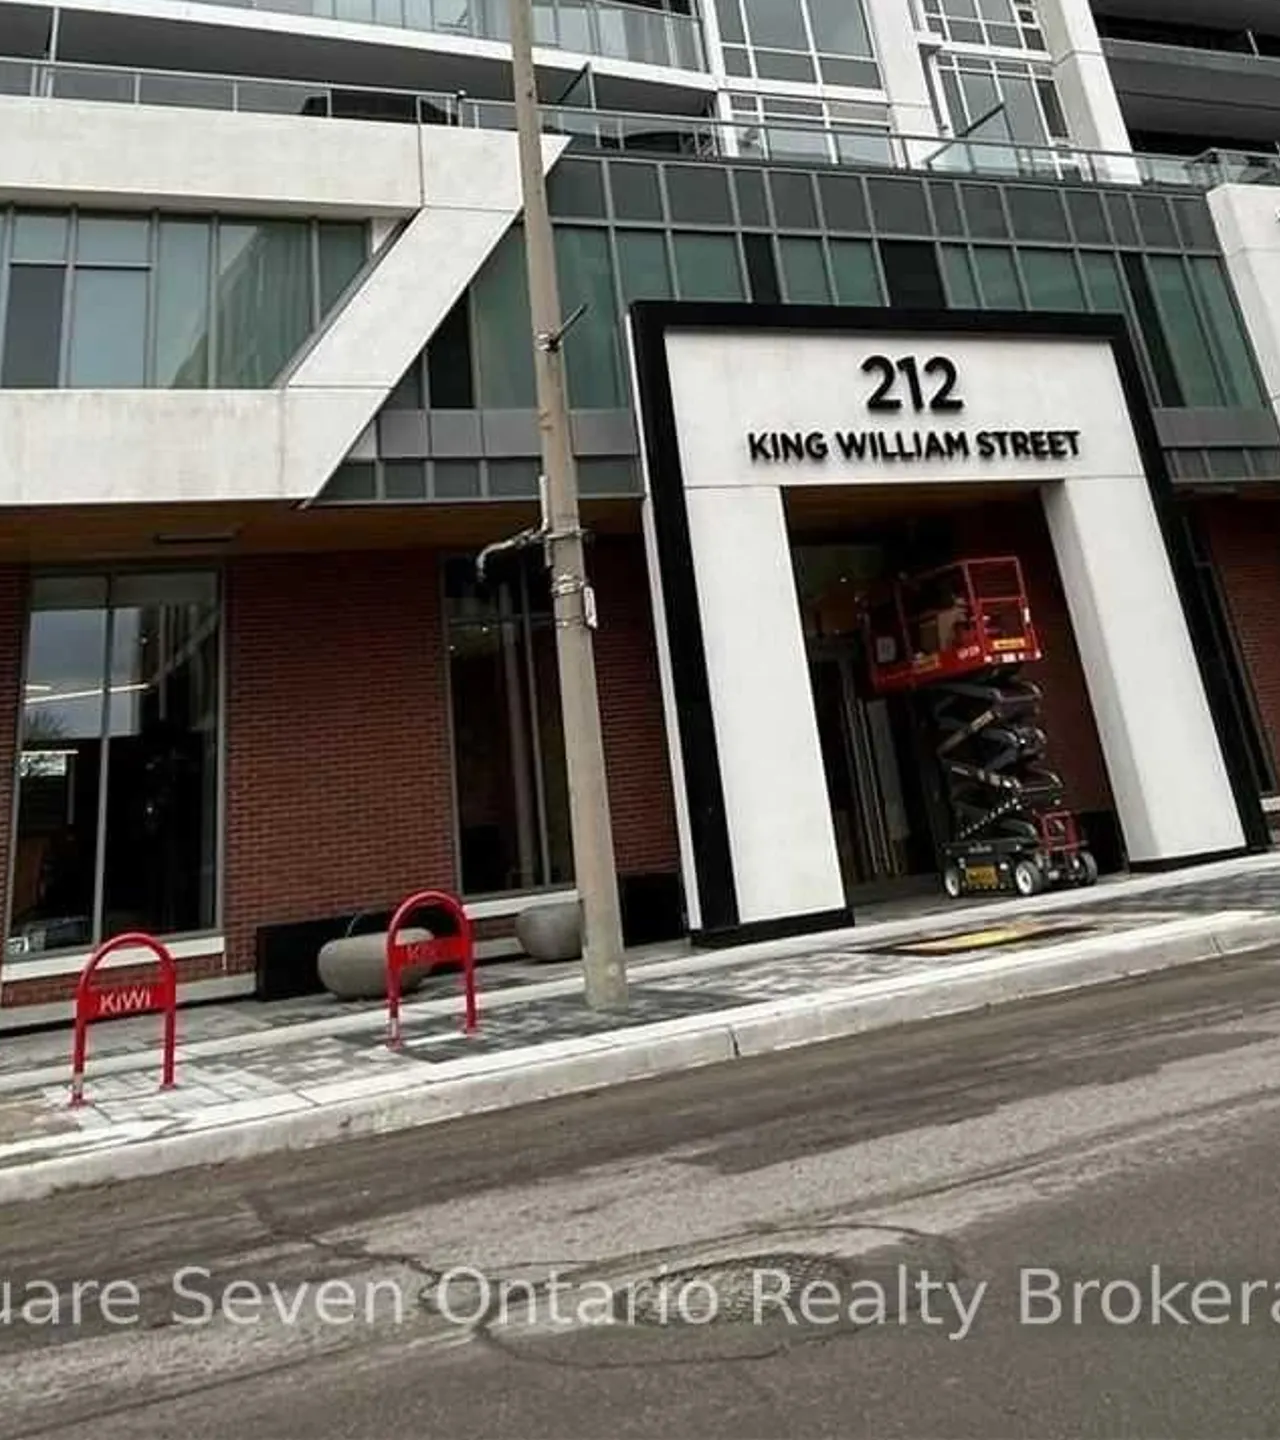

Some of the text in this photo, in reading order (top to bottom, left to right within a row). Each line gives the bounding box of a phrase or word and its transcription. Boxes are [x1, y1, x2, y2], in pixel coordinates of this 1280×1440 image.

[860, 355, 964, 414] 212
[747, 430, 1081, 462] KING WILLIAM STREET
